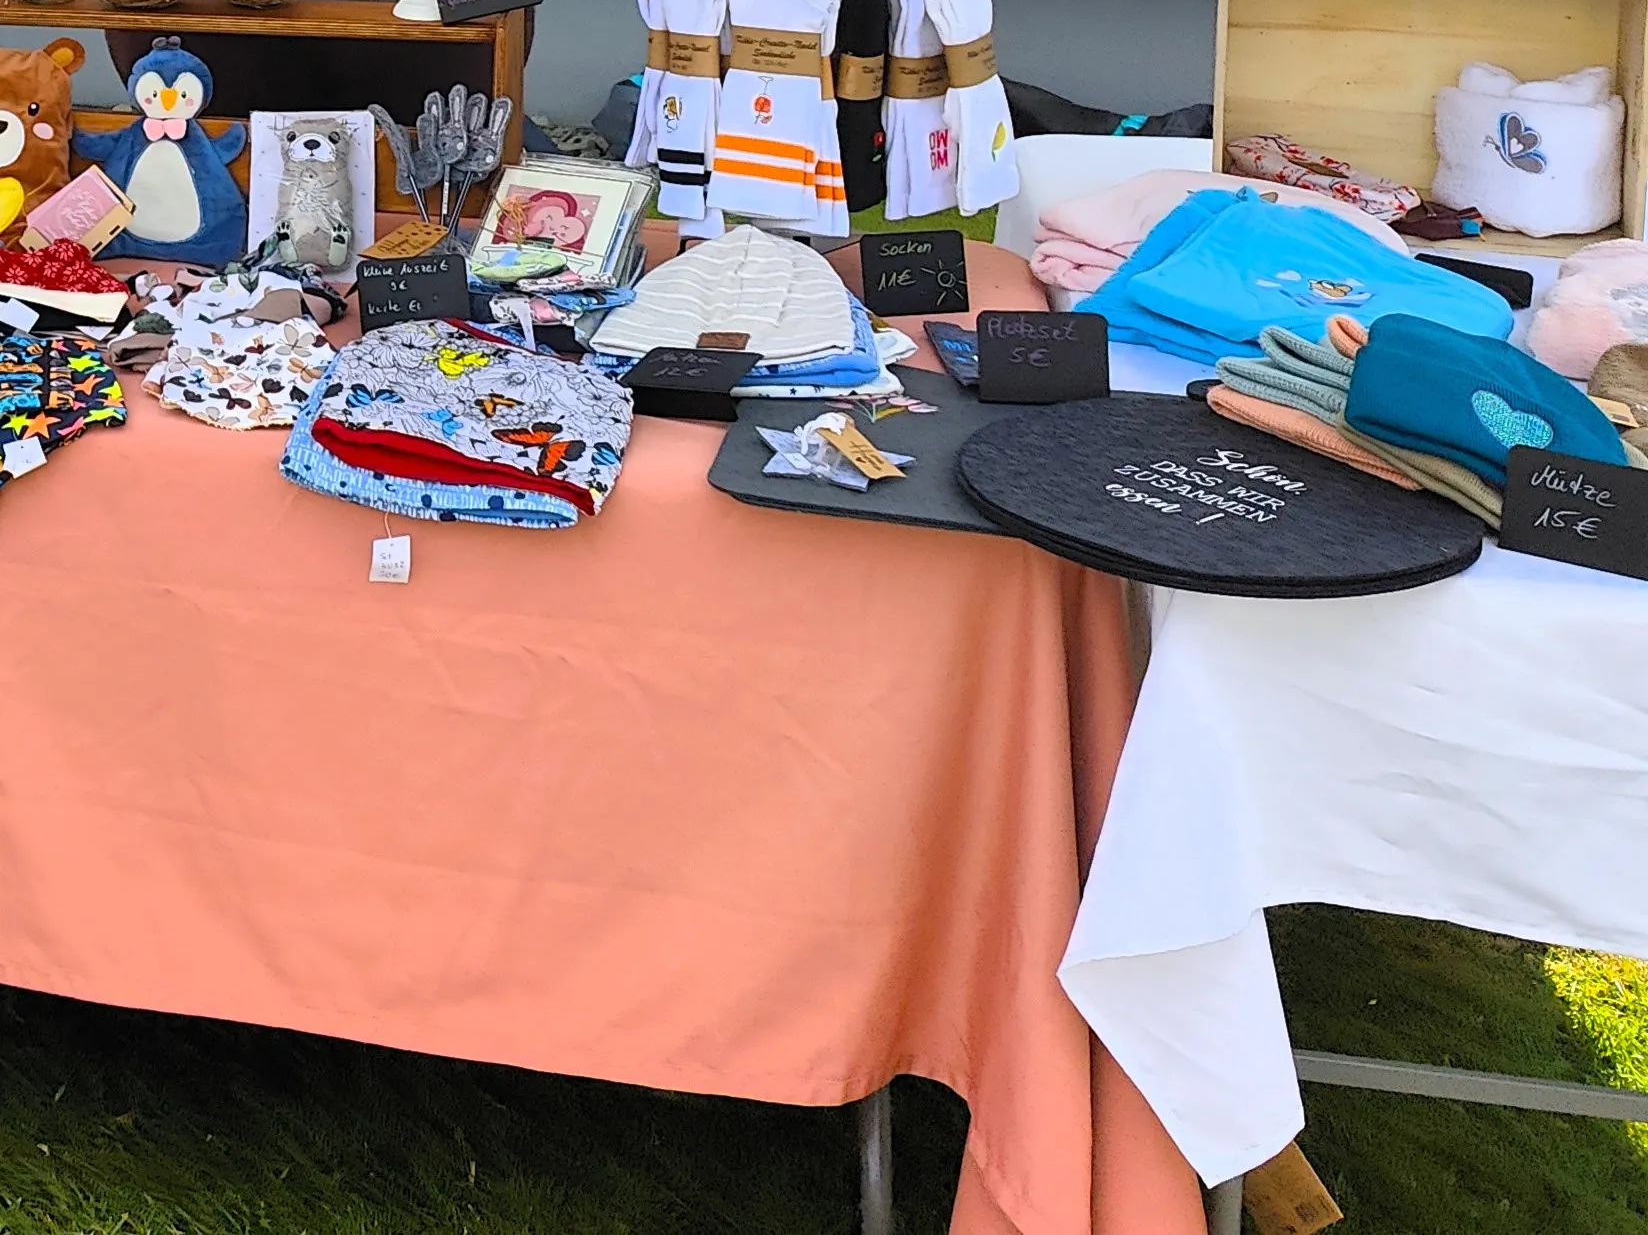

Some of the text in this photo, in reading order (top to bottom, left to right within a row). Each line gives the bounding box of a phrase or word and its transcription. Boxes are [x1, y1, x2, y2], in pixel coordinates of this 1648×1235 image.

[879, 240, 932, 256] Socken
[1009, 346, 1052, 368] 5€
[1113, 465, 1277, 523] ZUSAMMEN
[1150, 460, 1286, 511] DASS WIR
[1531, 465, 1617, 507] Mütze
[1533, 507, 1602, 539] 15€
